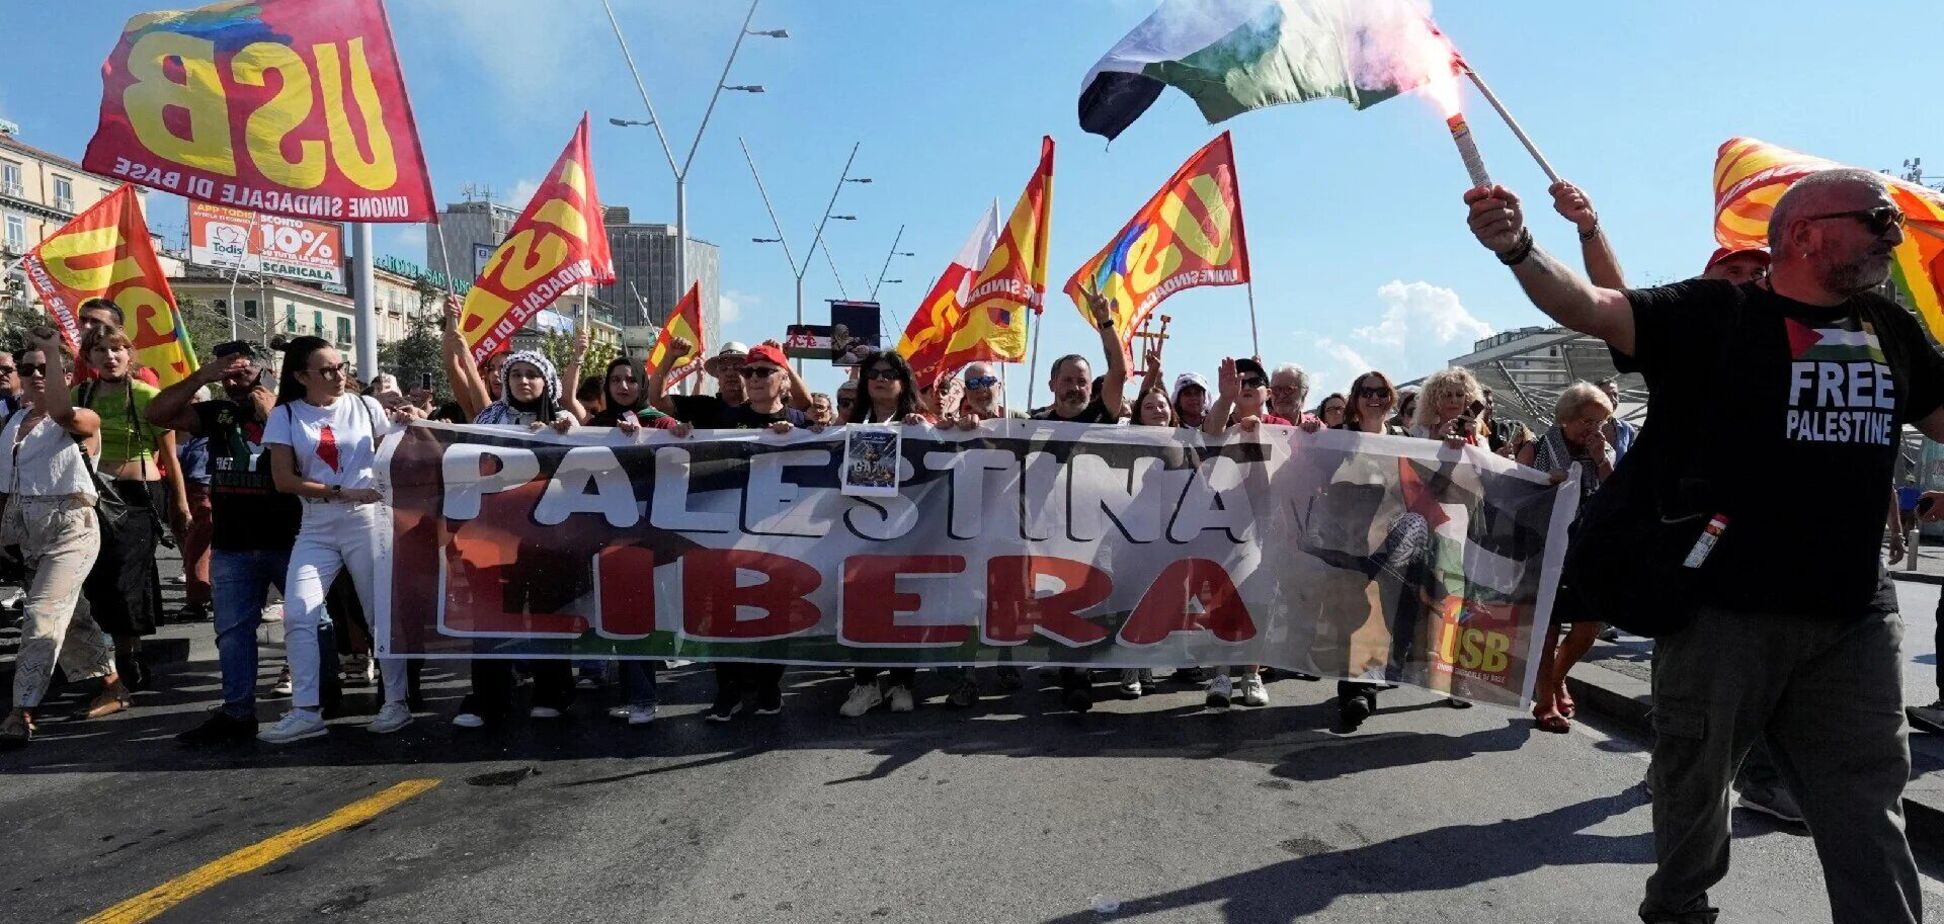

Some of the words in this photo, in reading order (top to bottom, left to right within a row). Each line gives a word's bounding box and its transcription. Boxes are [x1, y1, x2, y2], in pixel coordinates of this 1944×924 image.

[197, 204, 218, 214] APP
[260, 215, 304, 228] SCONTO
[212, 242, 244, 255] Todis
[261, 224, 333, 258] 10%
[262, 262, 333, 280] SCARICALA
[1788, 361, 1895, 410] FREE
[1786, 409, 1893, 446] PALESTINE
[442, 444, 1254, 544] PALESTINA
[438, 546, 1257, 649] LIBERA
[1440, 623, 1510, 672] USB
